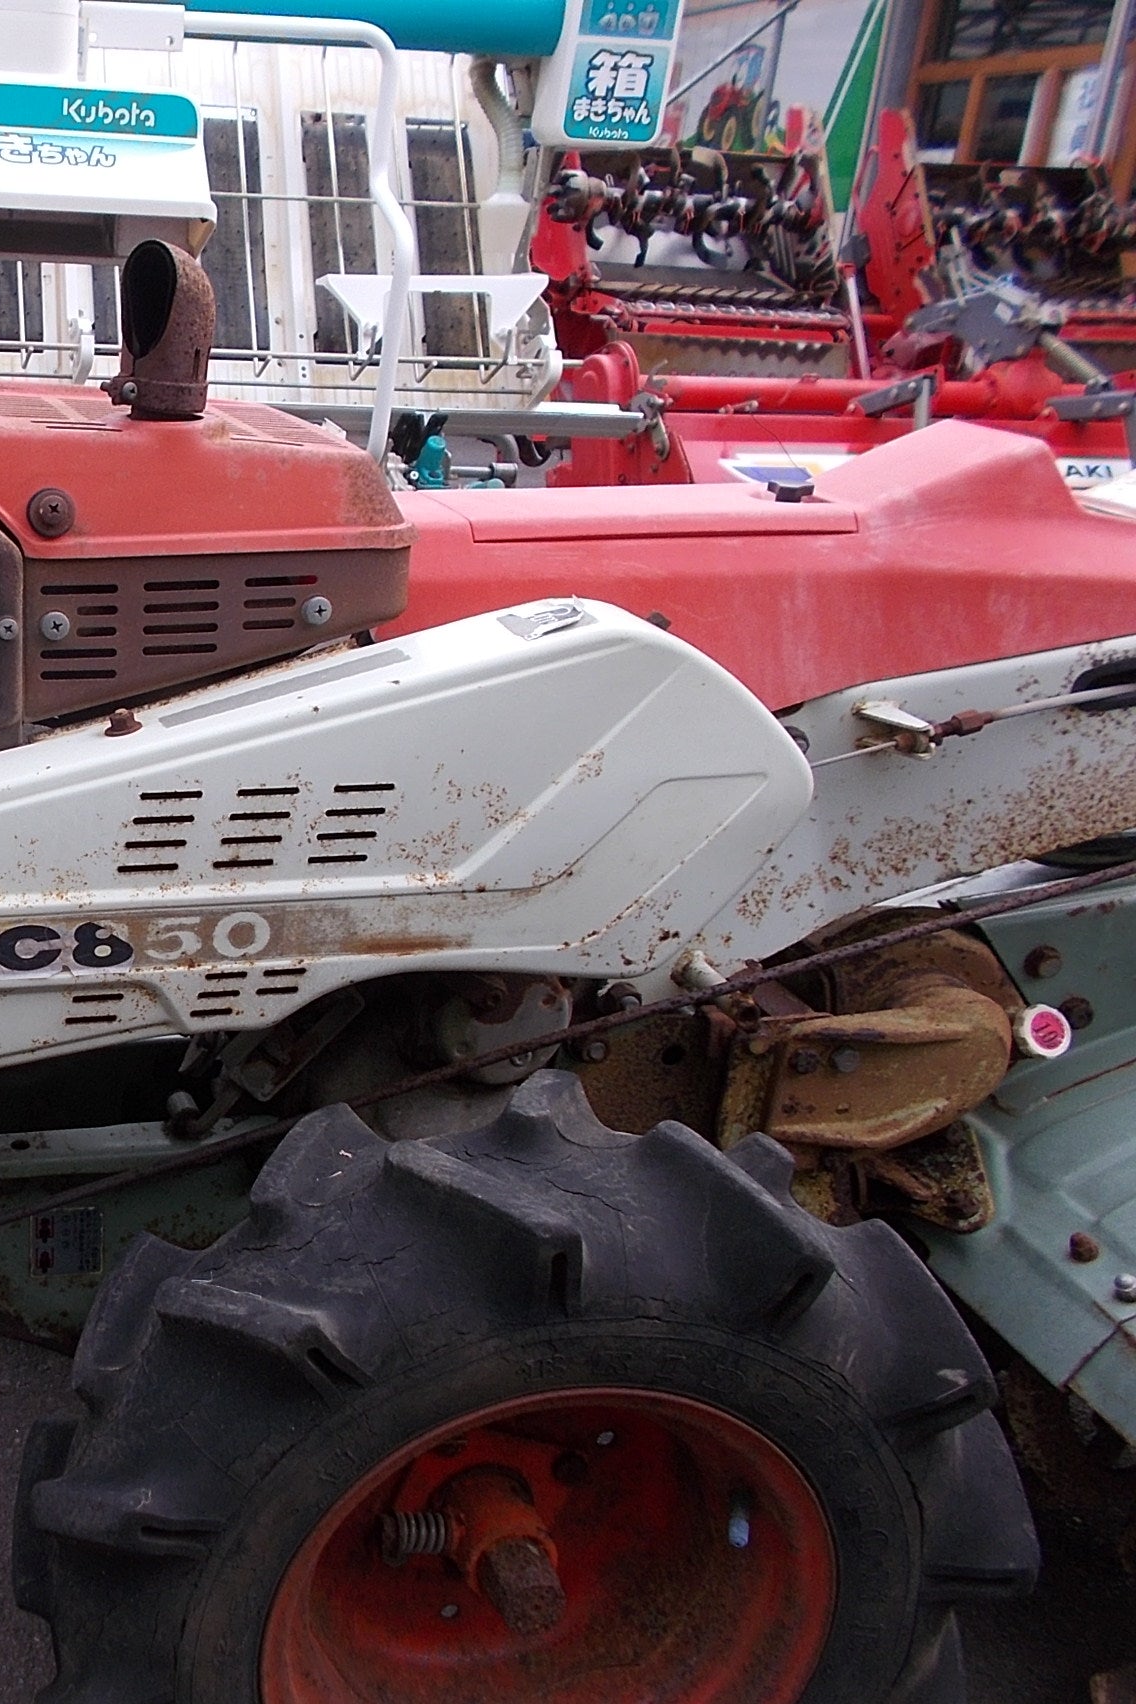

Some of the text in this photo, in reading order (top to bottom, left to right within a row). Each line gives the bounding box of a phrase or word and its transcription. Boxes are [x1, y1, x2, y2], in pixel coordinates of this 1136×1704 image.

[585, 49, 654, 99] 箱
[62, 97, 155, 128] Kubota
[573, 97, 651, 125] まきちゃん
[589, 126, 630, 140] Kubota
